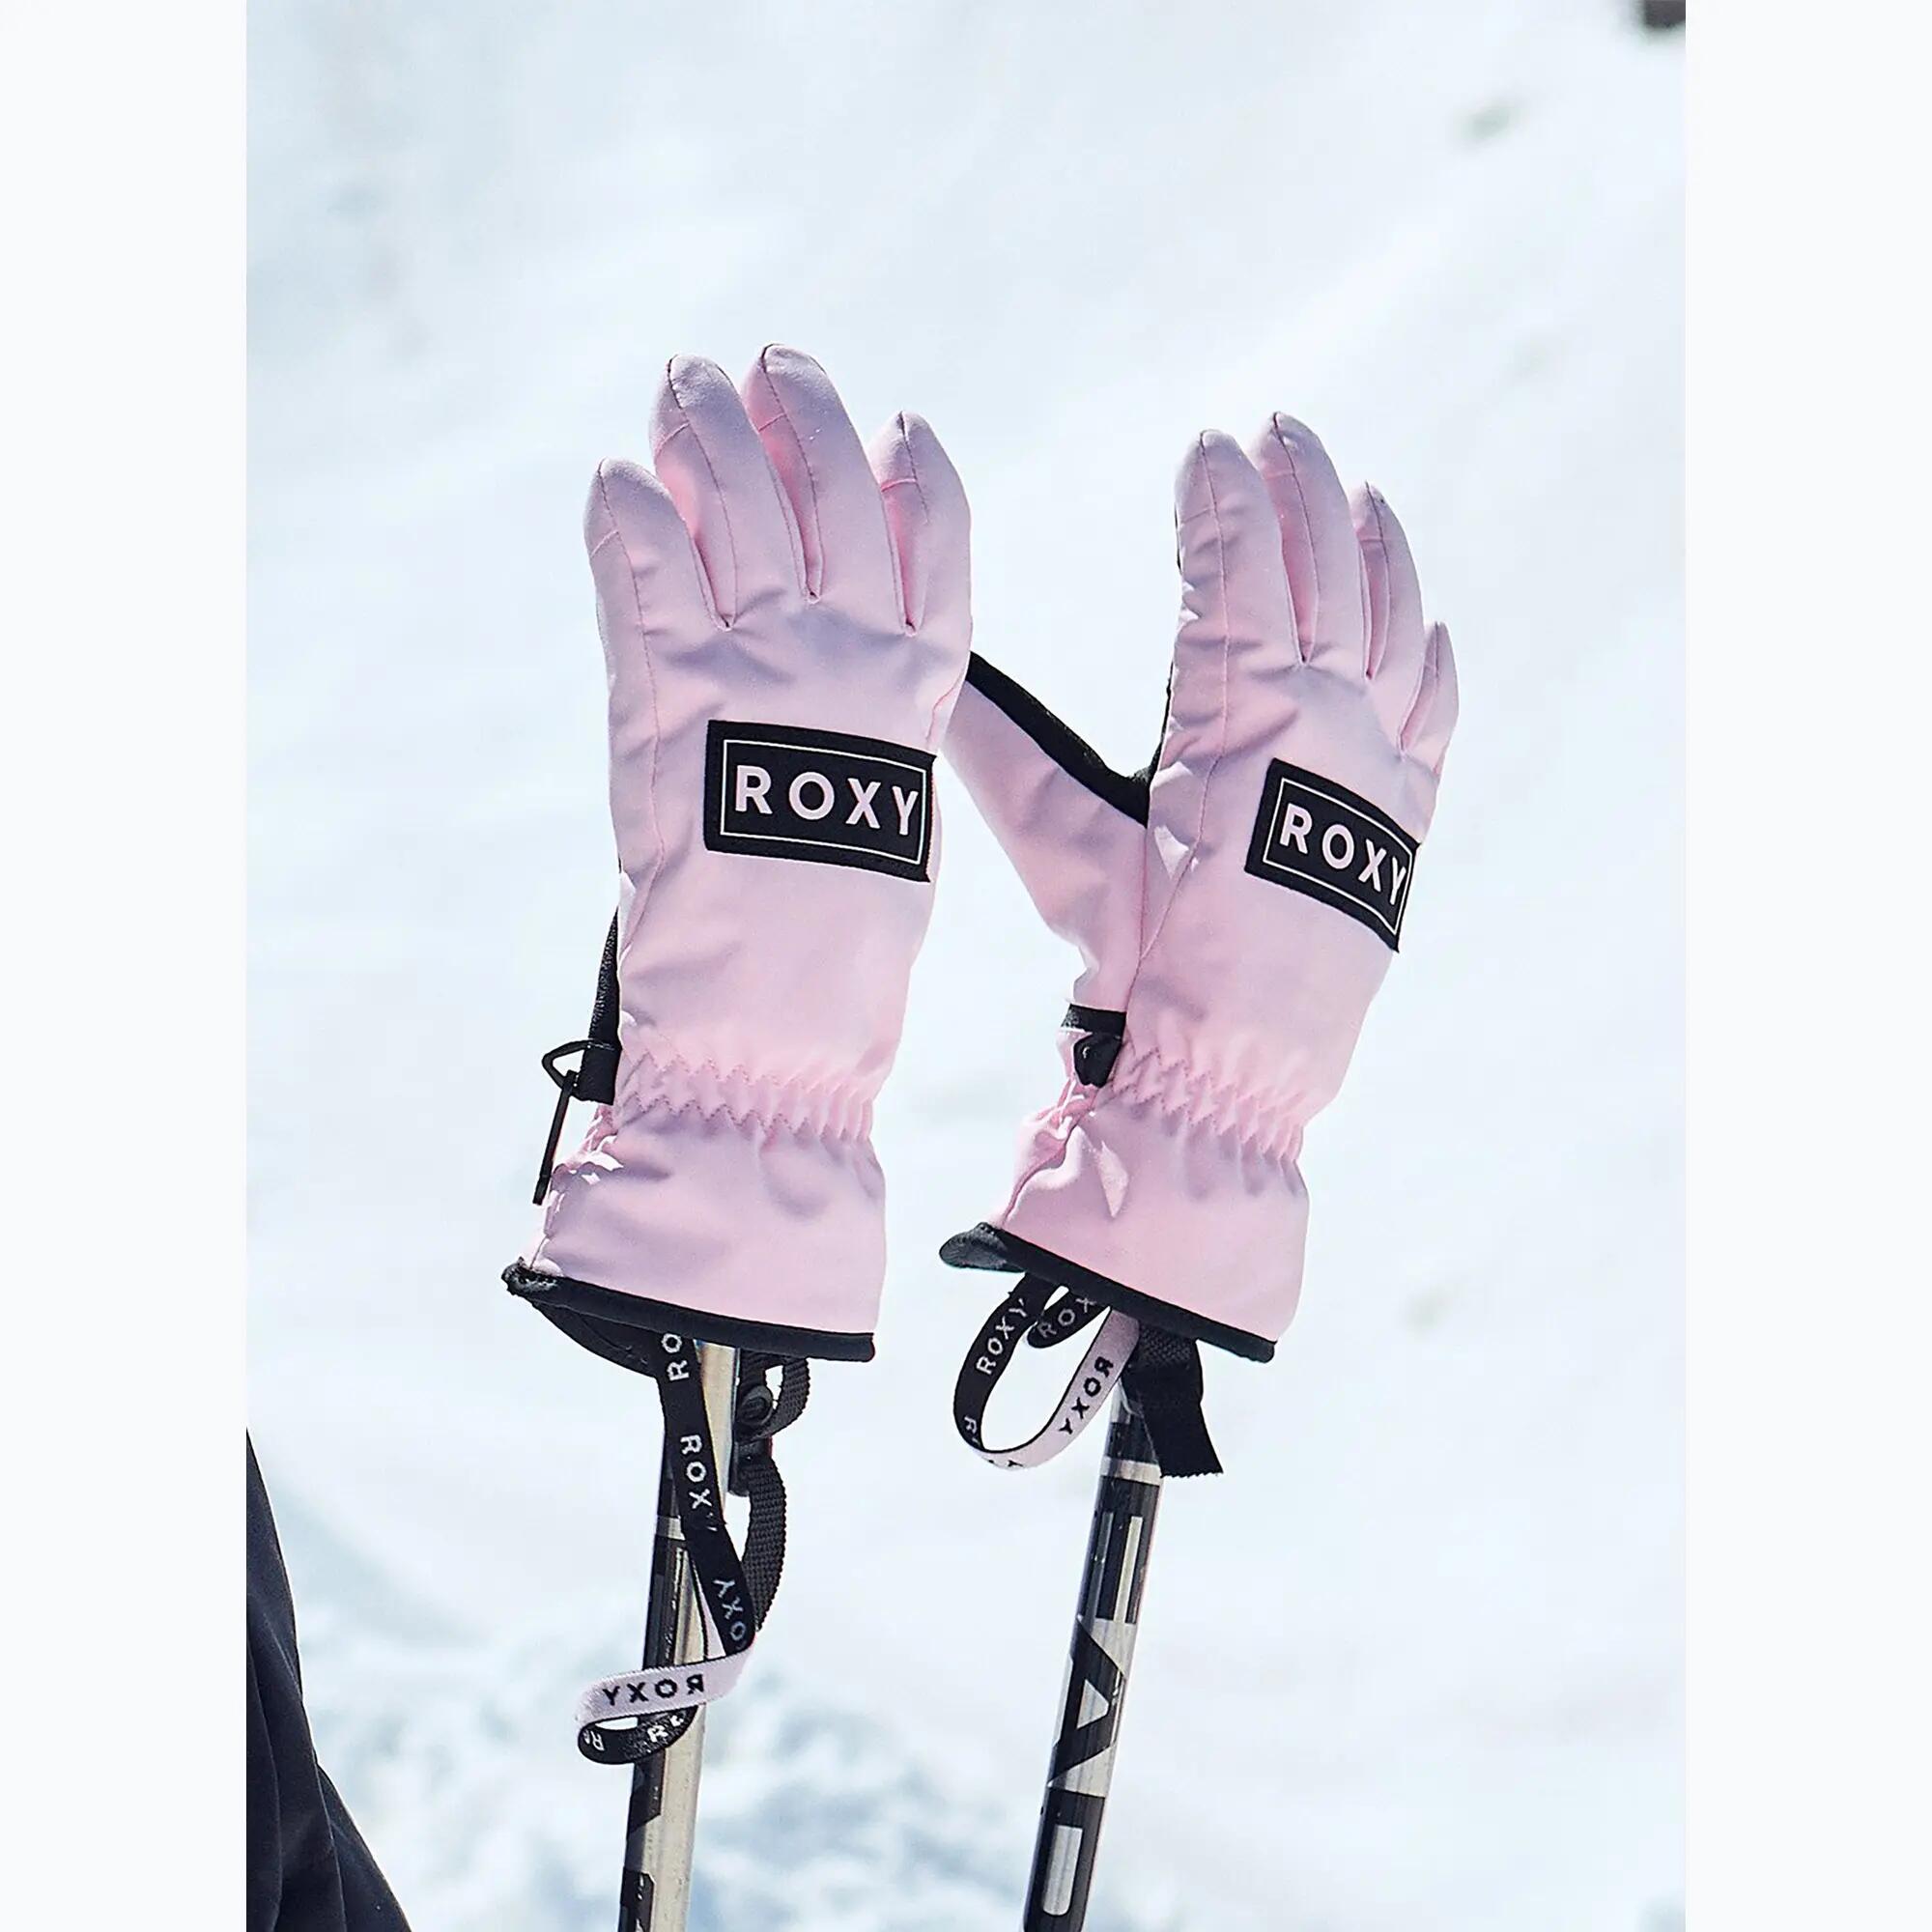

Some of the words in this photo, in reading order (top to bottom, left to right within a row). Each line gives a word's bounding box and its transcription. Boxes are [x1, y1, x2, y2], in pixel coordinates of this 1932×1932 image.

[735, 764, 919, 836] ROXY
[1279, 803, 1406, 906] ROXY
[976, 1298, 1028, 1376] ROXY
[679, 1435, 718, 1532] ROX
